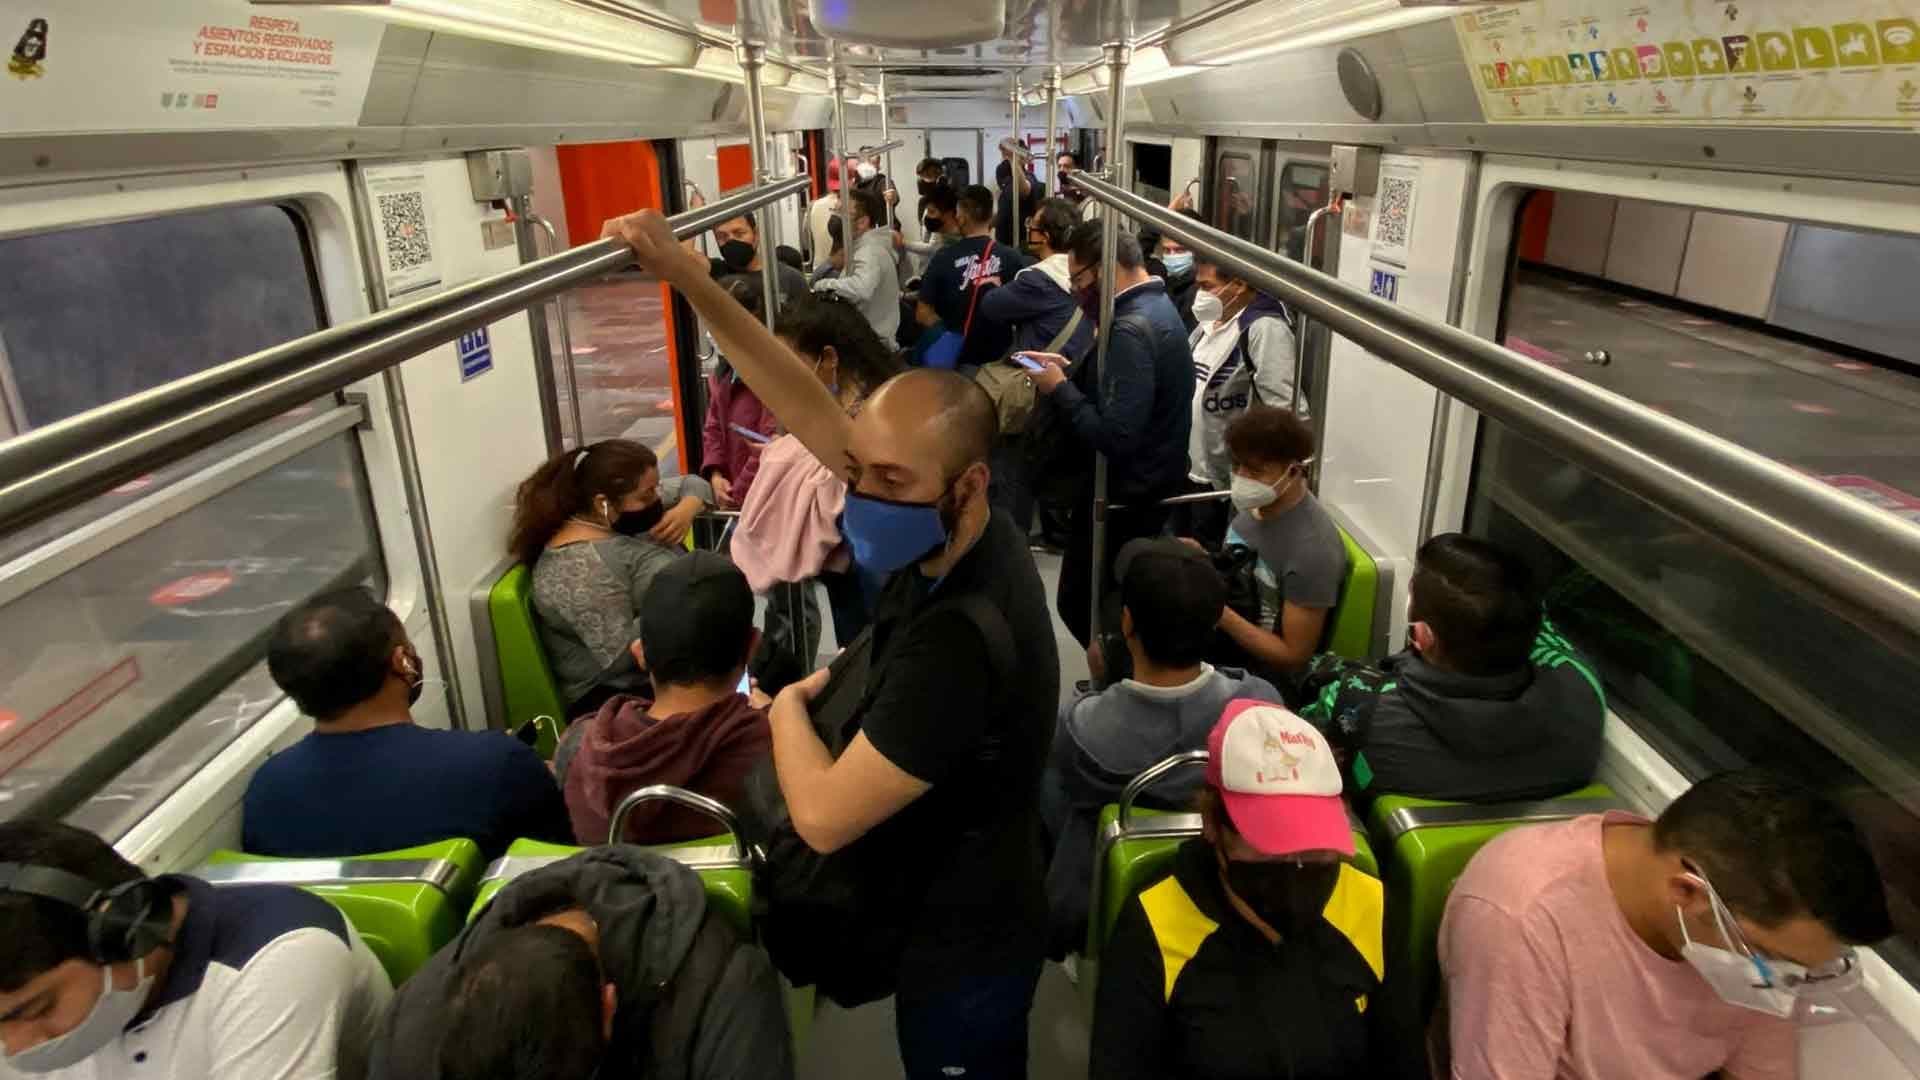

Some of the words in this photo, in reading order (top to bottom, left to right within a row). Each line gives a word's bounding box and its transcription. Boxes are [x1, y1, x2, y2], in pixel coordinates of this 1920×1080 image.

[250, 16, 299, 33] RESPETA
[197, 25, 262, 45] ASIENTOS
[263, 33, 334, 51] RESERVADOS
[193, 42, 203, 55] Y
[204, 43, 266, 60] ESPACIOS
[267, 50, 332, 65] EXCLUSIVOS
